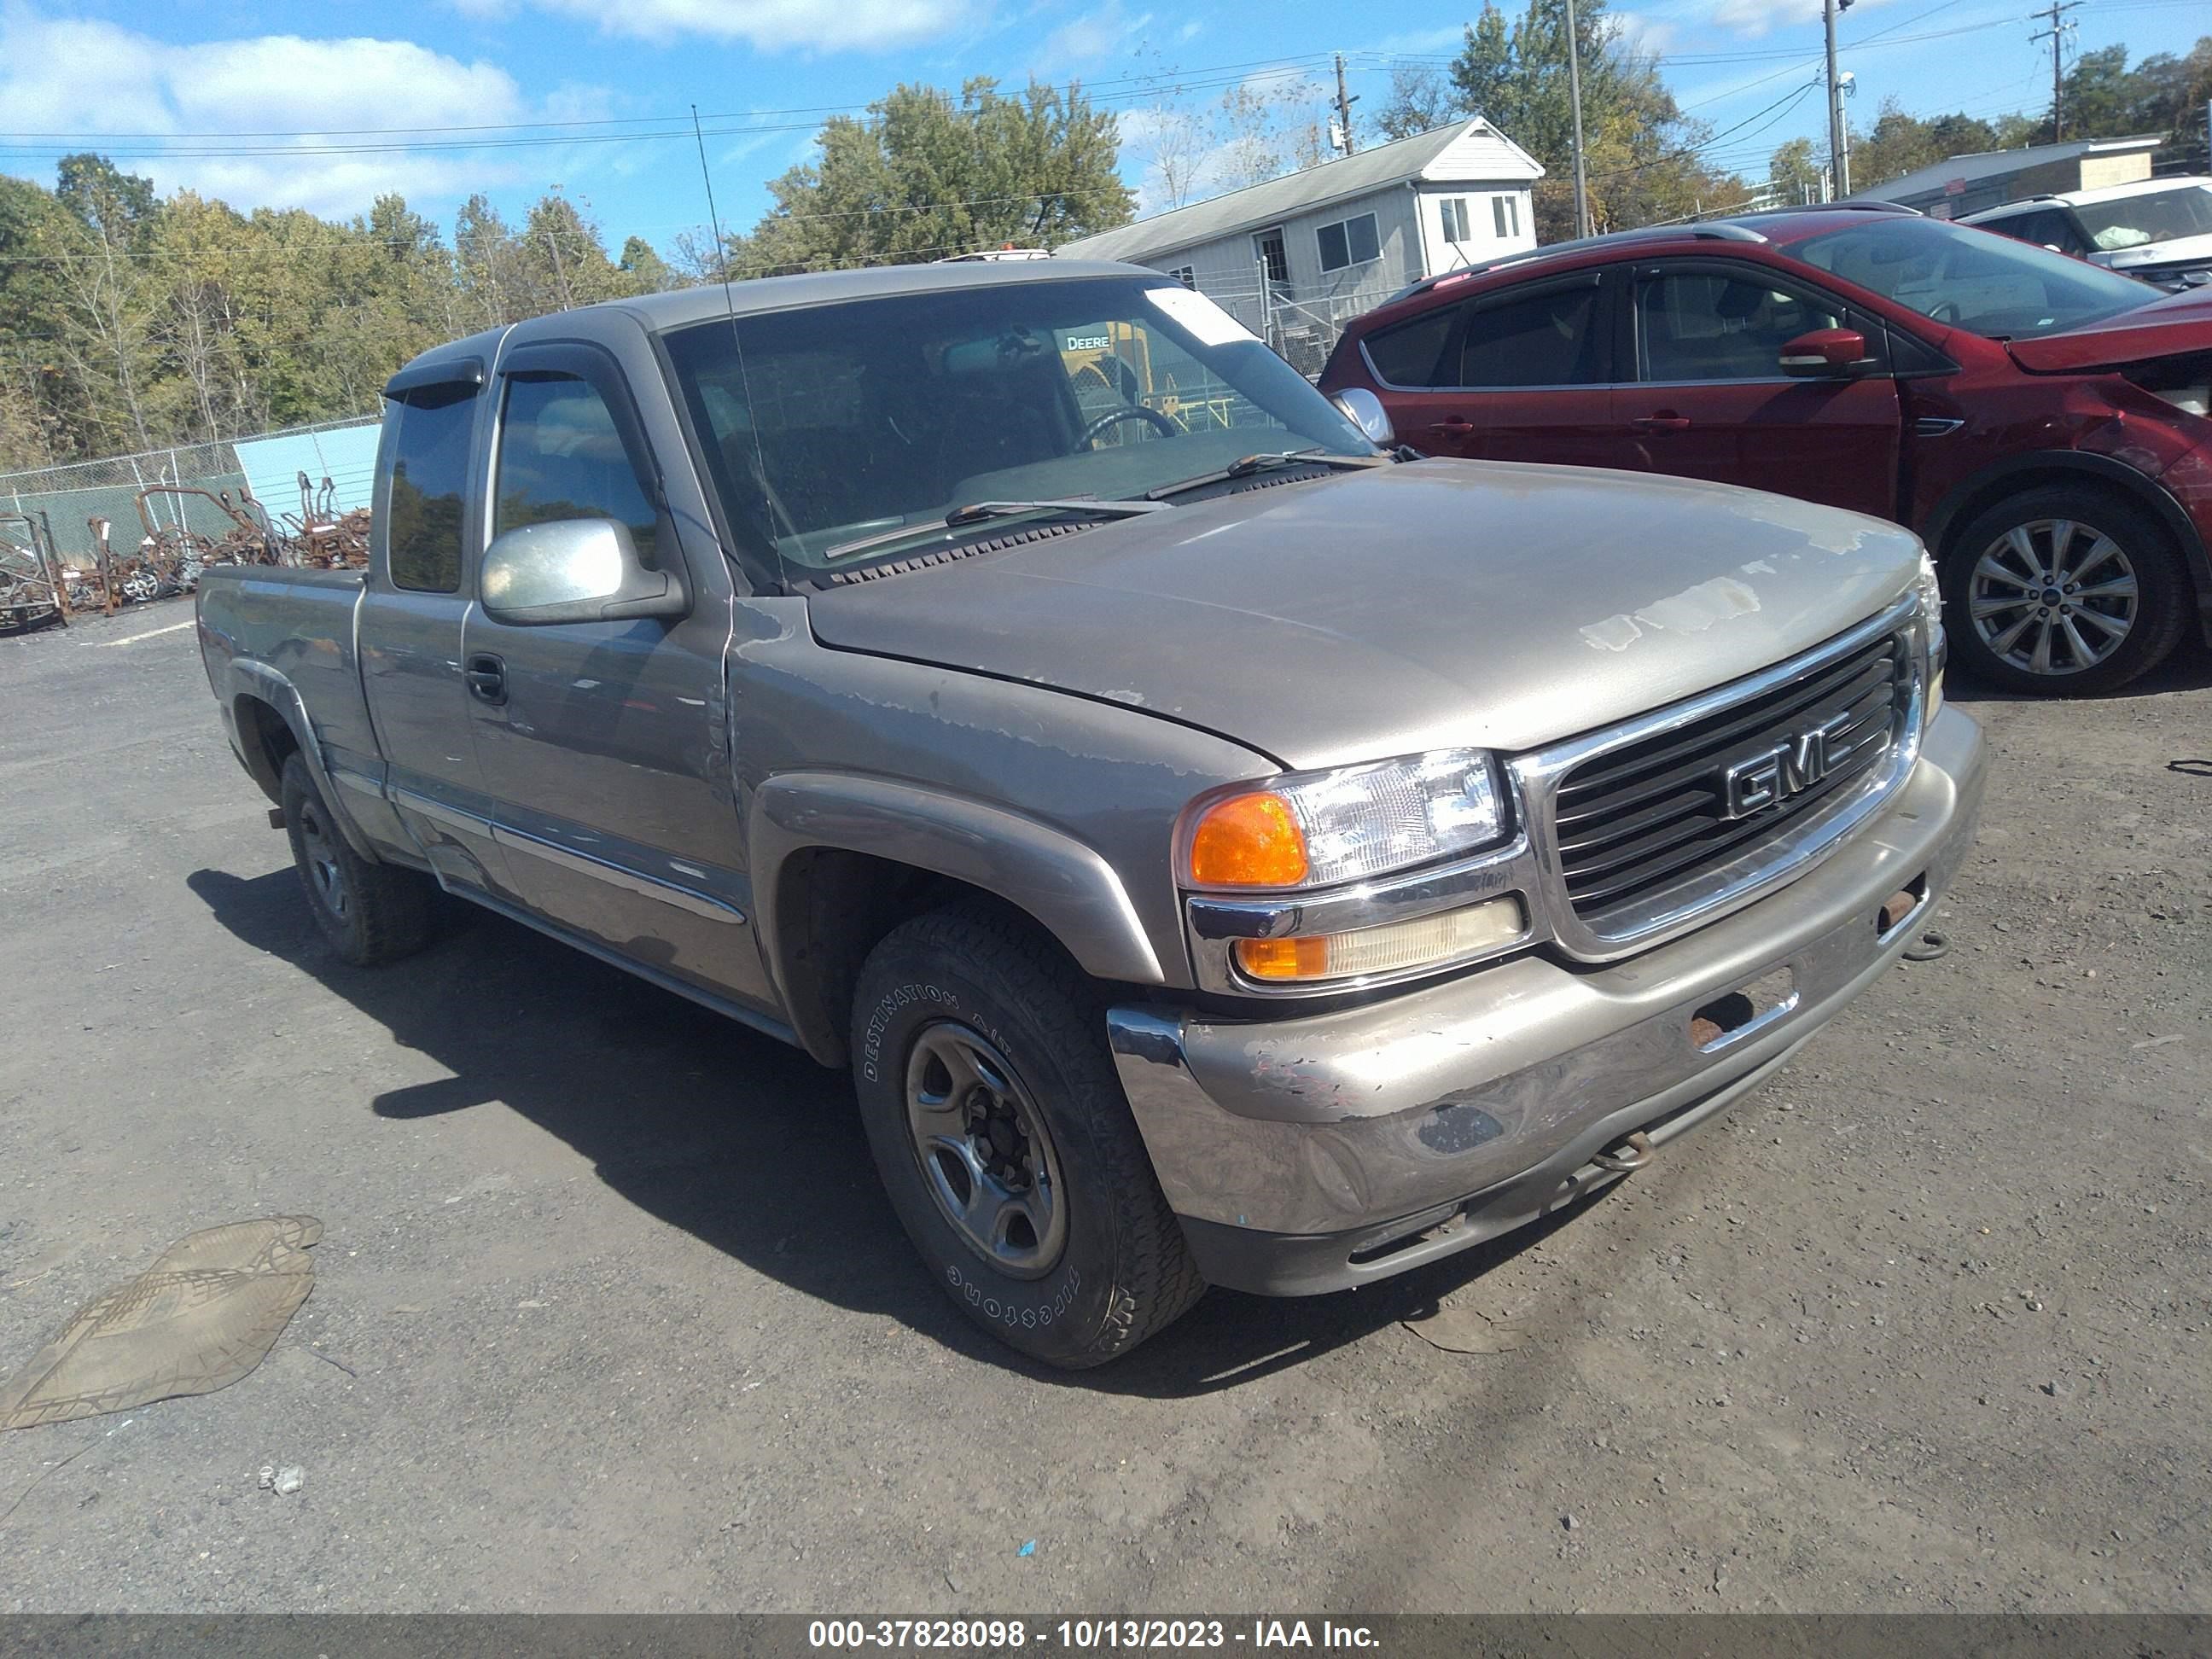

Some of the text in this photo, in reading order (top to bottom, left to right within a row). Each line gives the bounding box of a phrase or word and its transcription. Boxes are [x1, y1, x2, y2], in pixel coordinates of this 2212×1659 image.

[1067, 336, 1109, 351] DEERE
[1725, 711, 1851, 820] GMC
[864, 983, 960, 1082] DESTINATION
[946, 1265, 1080, 1329] Firestone
